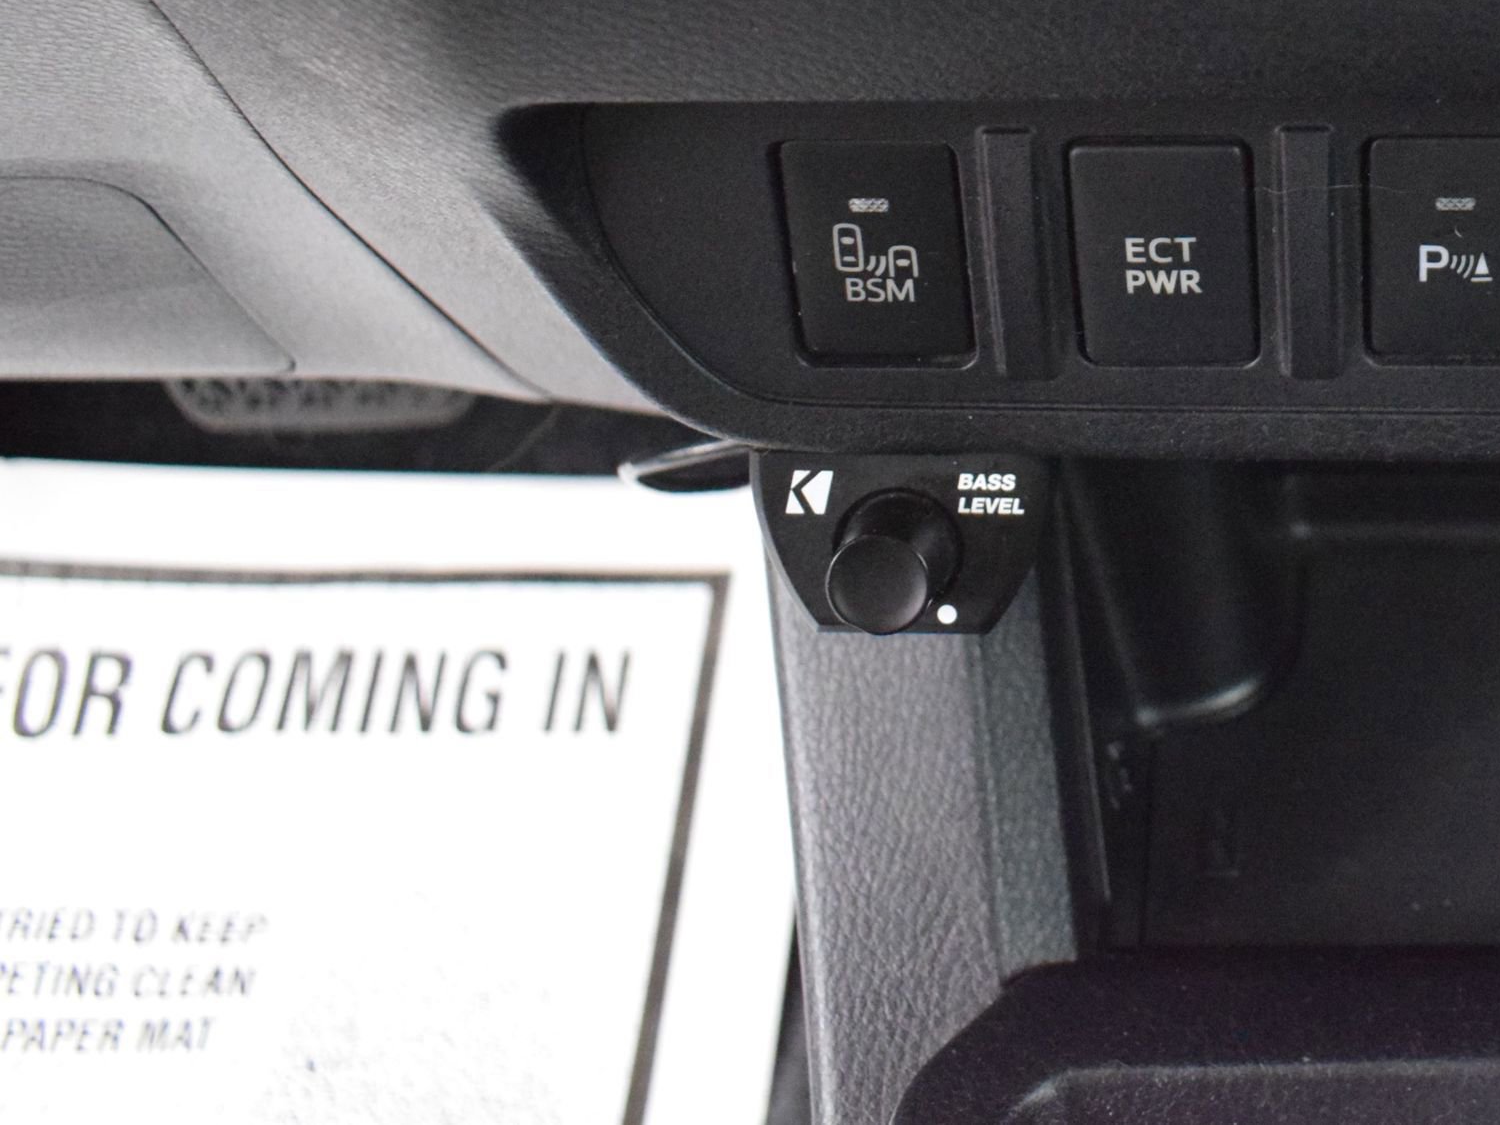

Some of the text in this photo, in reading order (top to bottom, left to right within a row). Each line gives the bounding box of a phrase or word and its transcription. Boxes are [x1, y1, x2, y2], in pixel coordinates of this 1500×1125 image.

[1124, 236, 1198, 264] ECT
[845, 277, 916, 303] BSM
[1125, 269, 1203, 295] PWR
[957, 473, 1017, 491] BASS
[957, 497, 1025, 515] LEVEL
[161, 648, 508, 736] COMING
[541, 649, 633, 735] IN
[112, 908, 160, 945] TO
[169, 911, 269, 946] KEEP
[129, 962, 257, 998] CLEAN
[1, 1017, 217, 1054] PAPER MAT
